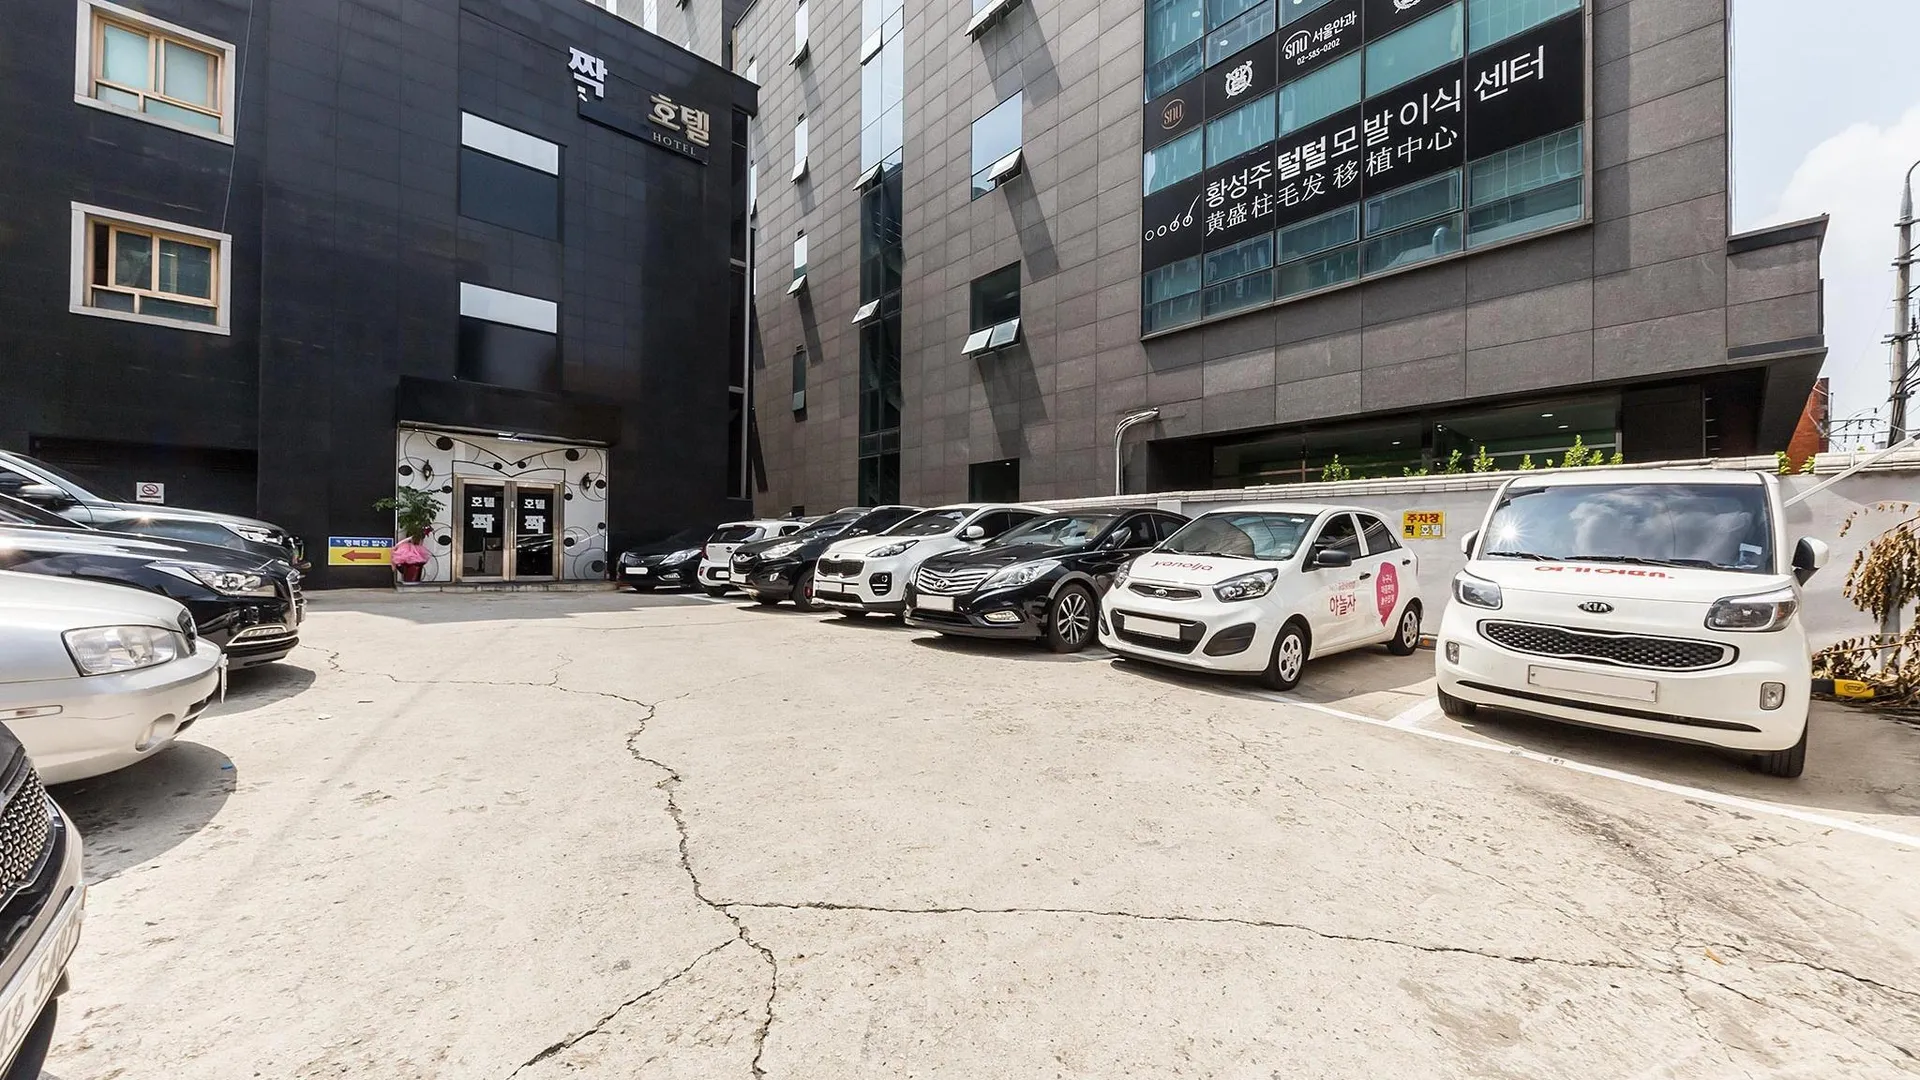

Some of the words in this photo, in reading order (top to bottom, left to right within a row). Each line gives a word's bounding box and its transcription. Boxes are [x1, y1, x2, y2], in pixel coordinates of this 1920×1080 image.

[1312, 10, 1358, 43] 서울안과
[1296, 38, 1341, 66] 02-585-0202
[568, 46, 608, 99] 짝
[648, 93, 710, 147] 호텔
[1206, 160, 1273, 208] 황성주
[1277, 135, 1327, 181] 털털
[1473, 45, 1545, 102] 센터
[652, 131, 697, 156] HOTEL
[1407, 513, 1440, 524] 주차장
[1150, 560, 1213, 571] yanolja
[1329, 592, 1357, 616] 야놀자
[1583, 602, 1609, 613] KIA
